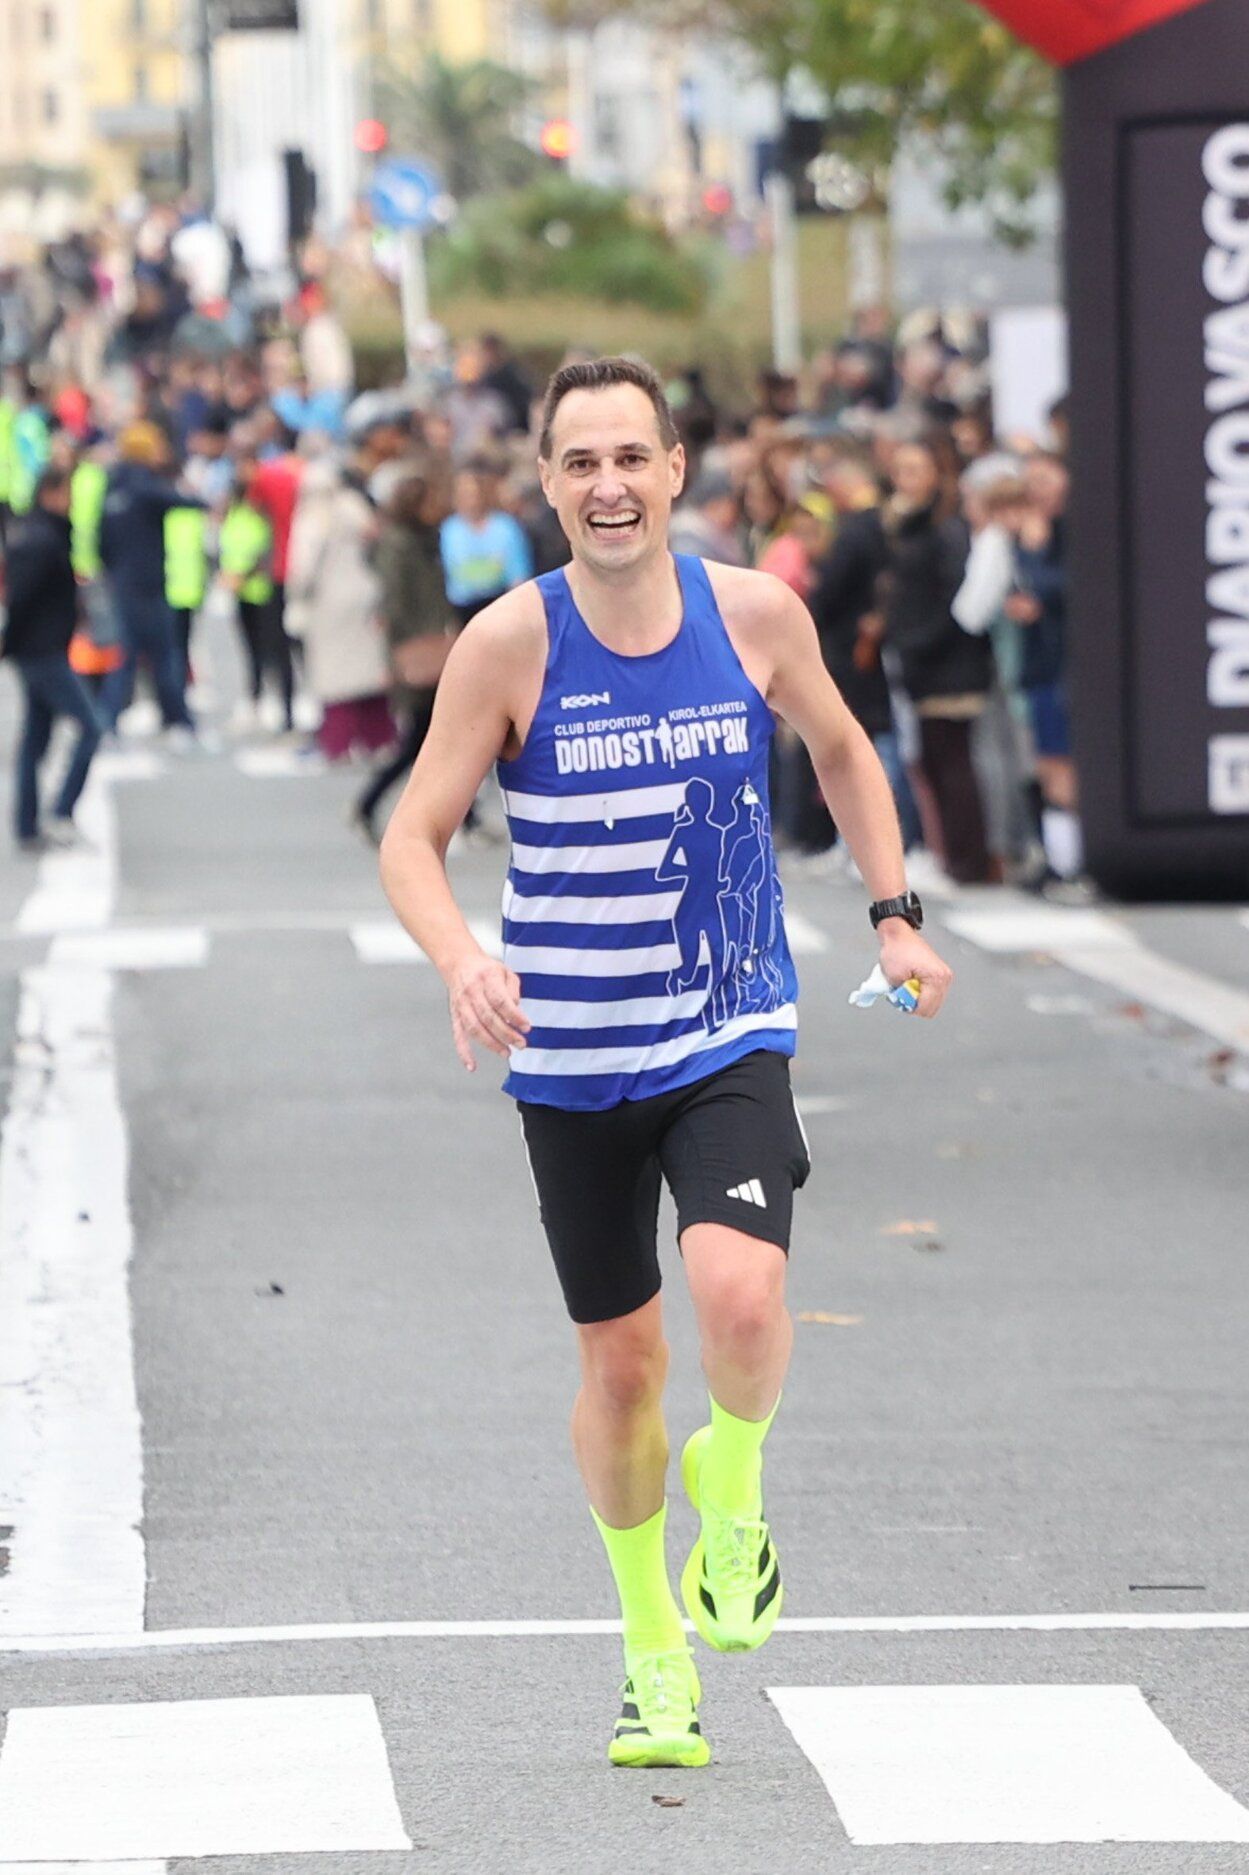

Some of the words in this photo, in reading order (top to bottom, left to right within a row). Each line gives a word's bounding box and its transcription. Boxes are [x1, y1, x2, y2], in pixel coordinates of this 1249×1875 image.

[668, 701, 748, 720] KIROL-ELKARTEA
[554, 723, 585, 736] CLUB
[586, 714, 650, 733] DEPORTIVO
